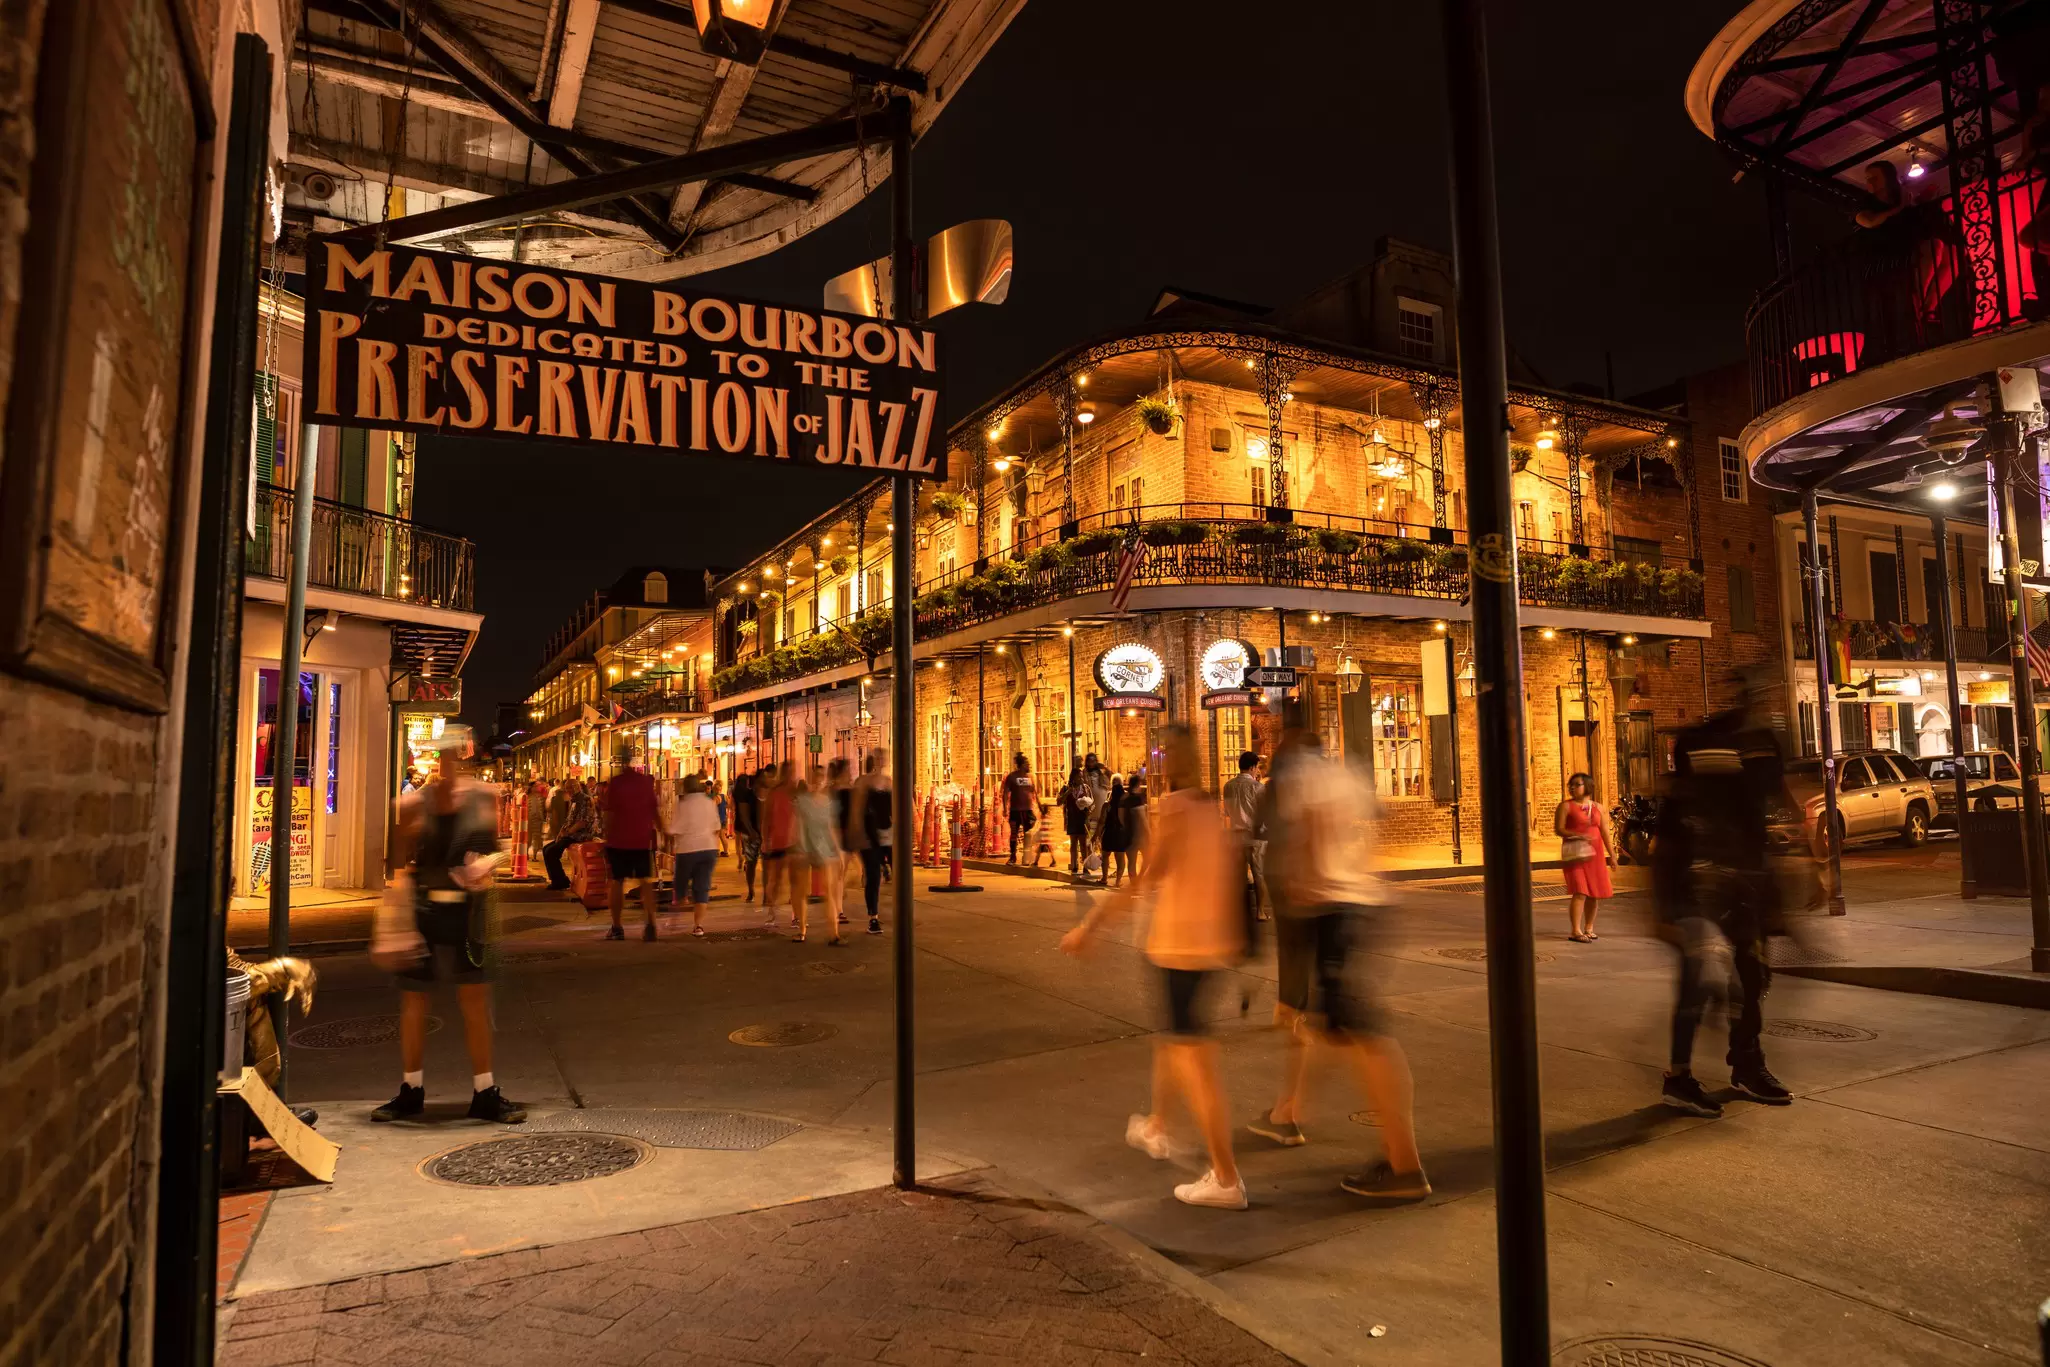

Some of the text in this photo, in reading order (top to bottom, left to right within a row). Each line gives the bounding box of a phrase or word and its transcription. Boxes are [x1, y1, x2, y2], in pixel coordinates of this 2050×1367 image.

[322, 241, 937, 373] MAISON BOURBON
[421, 312, 872, 393] DEDICATED TO THE
[314, 308, 939, 474] PRESERVATION OF JAZZ
[1116, 665, 1145, 683] CORNET
[1214, 664, 1236, 679] CORNET
[1262, 672, 1292, 681] ONE WAY
[1102, 697, 1161, 707] NEW ORLEANS CUISINE
[1214, 694, 1233, 703] ORLEANS
[291, 822, 307, 831] Bar
